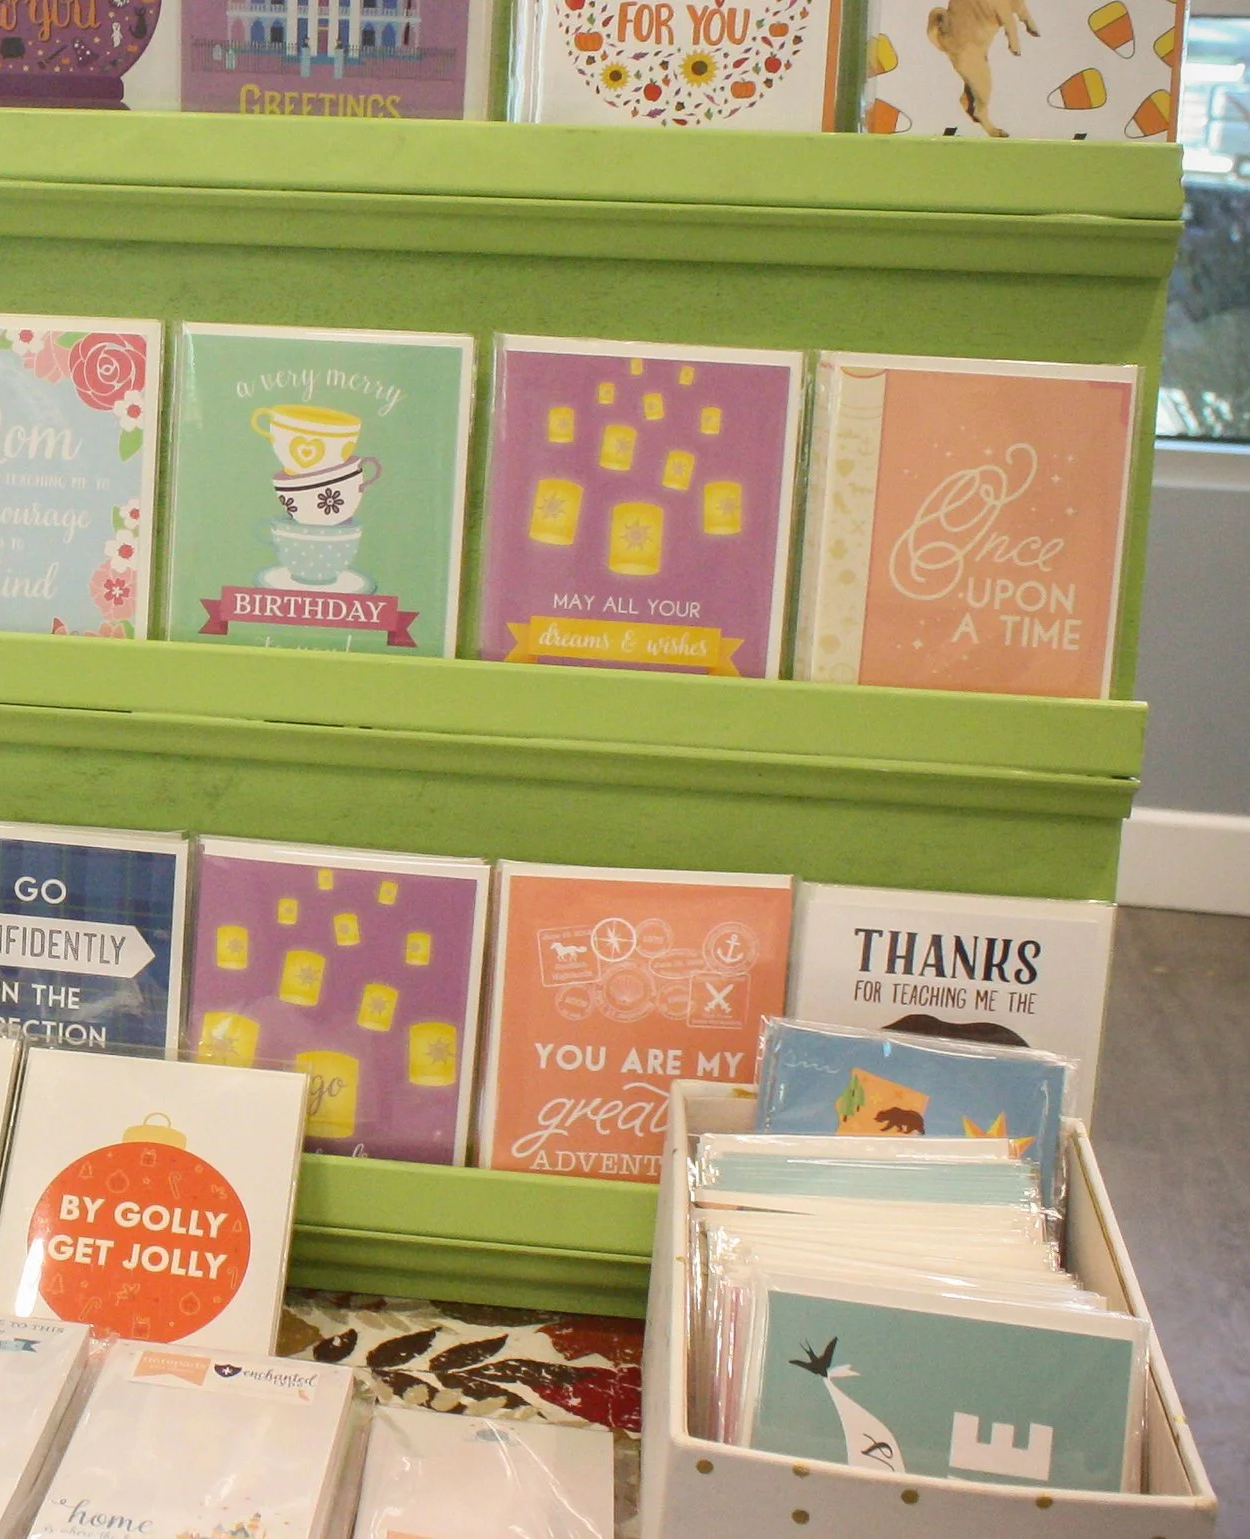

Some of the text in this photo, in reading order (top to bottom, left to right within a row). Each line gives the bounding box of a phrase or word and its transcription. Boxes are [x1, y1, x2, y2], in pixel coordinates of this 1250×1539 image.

[29, 0, 102, 41] you
[617, 1, 750, 46] FOR YOU
[236, 368, 408, 417] a very merry
[889, 442, 1065, 601] Once
[233, 592, 387, 623] BIRTHDAY
[553, 592, 701, 618] MAY ALL YOUR
[965, 577, 1076, 614] UPON
[538, 621, 708, 657] dreams & wishes
[952, 612, 1082, 650] A TIME
[13, 875, 67, 905] GO
[854, 928, 1042, 985] THANKS
[31, 983, 81, 1010] THE
[854, 979, 1038, 1015] FOR TEACHING ME THE
[534, 1042, 744, 1078] YOU ARE MY
[529, 1149, 662, 1176] ADVENT
[59, 1193, 229, 1239] BY GOLLY
[47, 1234, 228, 1280] GET JOLLY
[31, 1324, 65, 1334] THIS
[243, 1368, 319, 1388] enchanted
[50, 1499, 154, 1533] home
